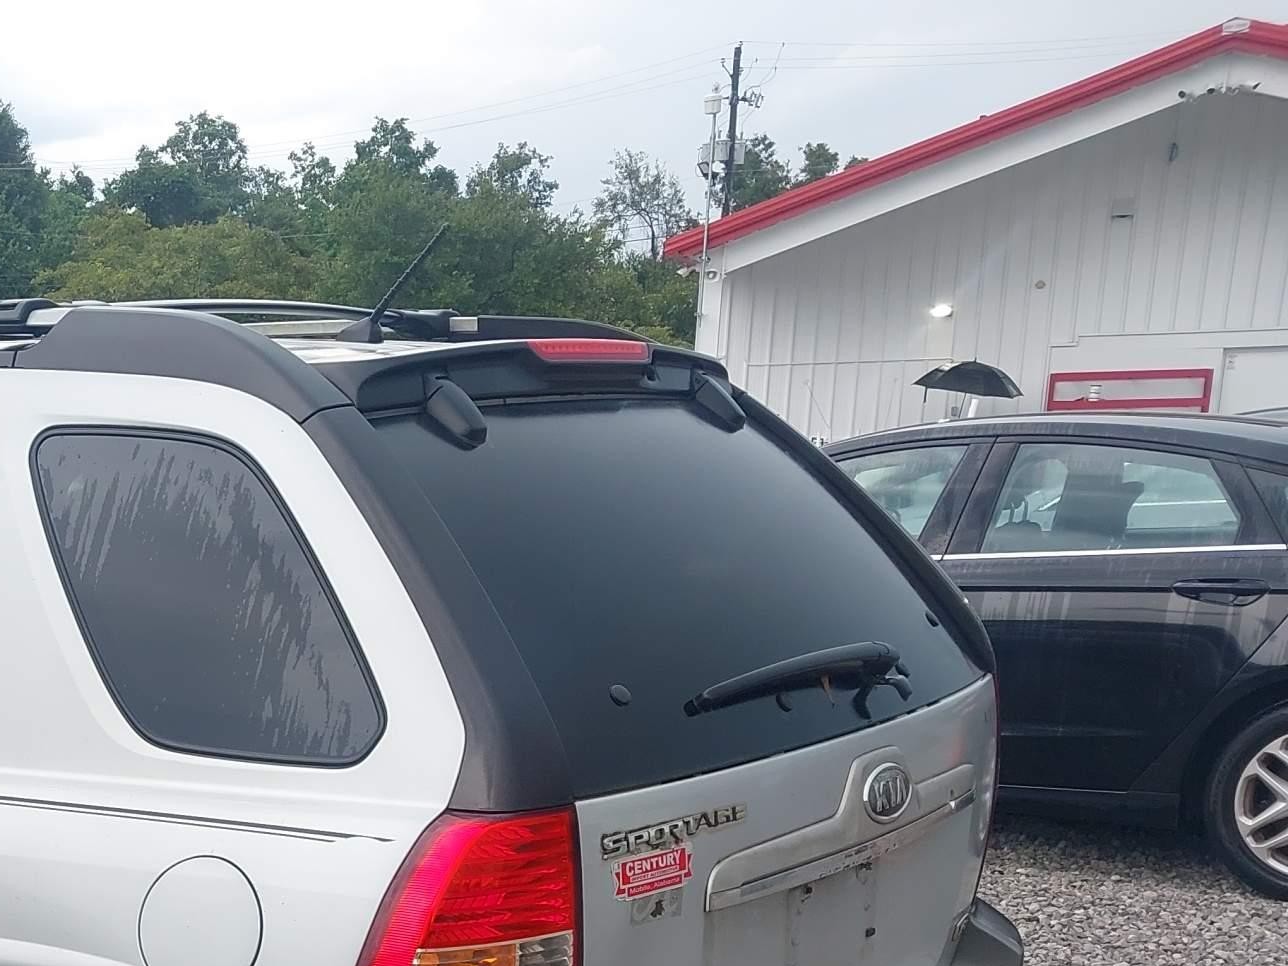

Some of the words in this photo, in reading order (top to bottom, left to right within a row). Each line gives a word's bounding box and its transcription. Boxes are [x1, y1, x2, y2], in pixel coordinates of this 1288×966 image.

[872, 774, 909, 812] KIA
[601, 806, 746, 860] SPORTAGE
[625, 849, 681, 877] CENTURY
